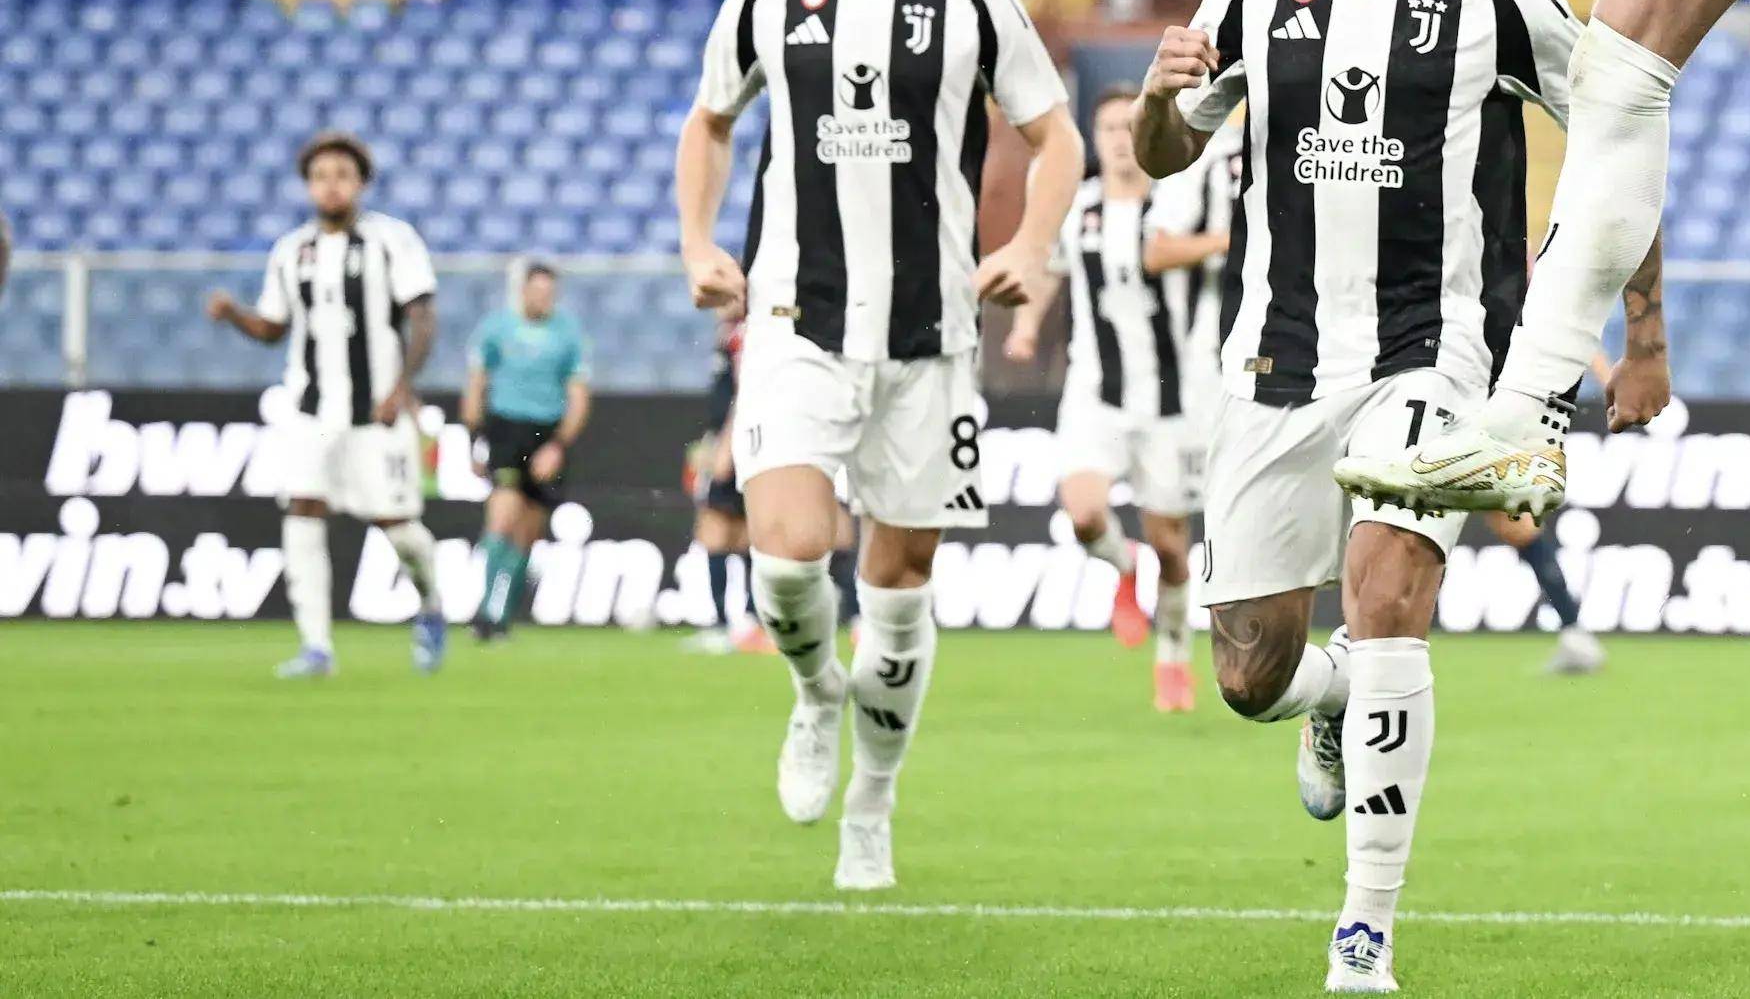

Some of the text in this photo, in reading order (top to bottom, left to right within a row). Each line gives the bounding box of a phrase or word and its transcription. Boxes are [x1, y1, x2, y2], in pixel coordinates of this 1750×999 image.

[822, 118, 906, 136] Save the
[821, 141, 909, 158] Children
[1300, 132, 1401, 157] Save the
[1298, 159, 1400, 185] Children
[951, 414, 980, 471] 8
